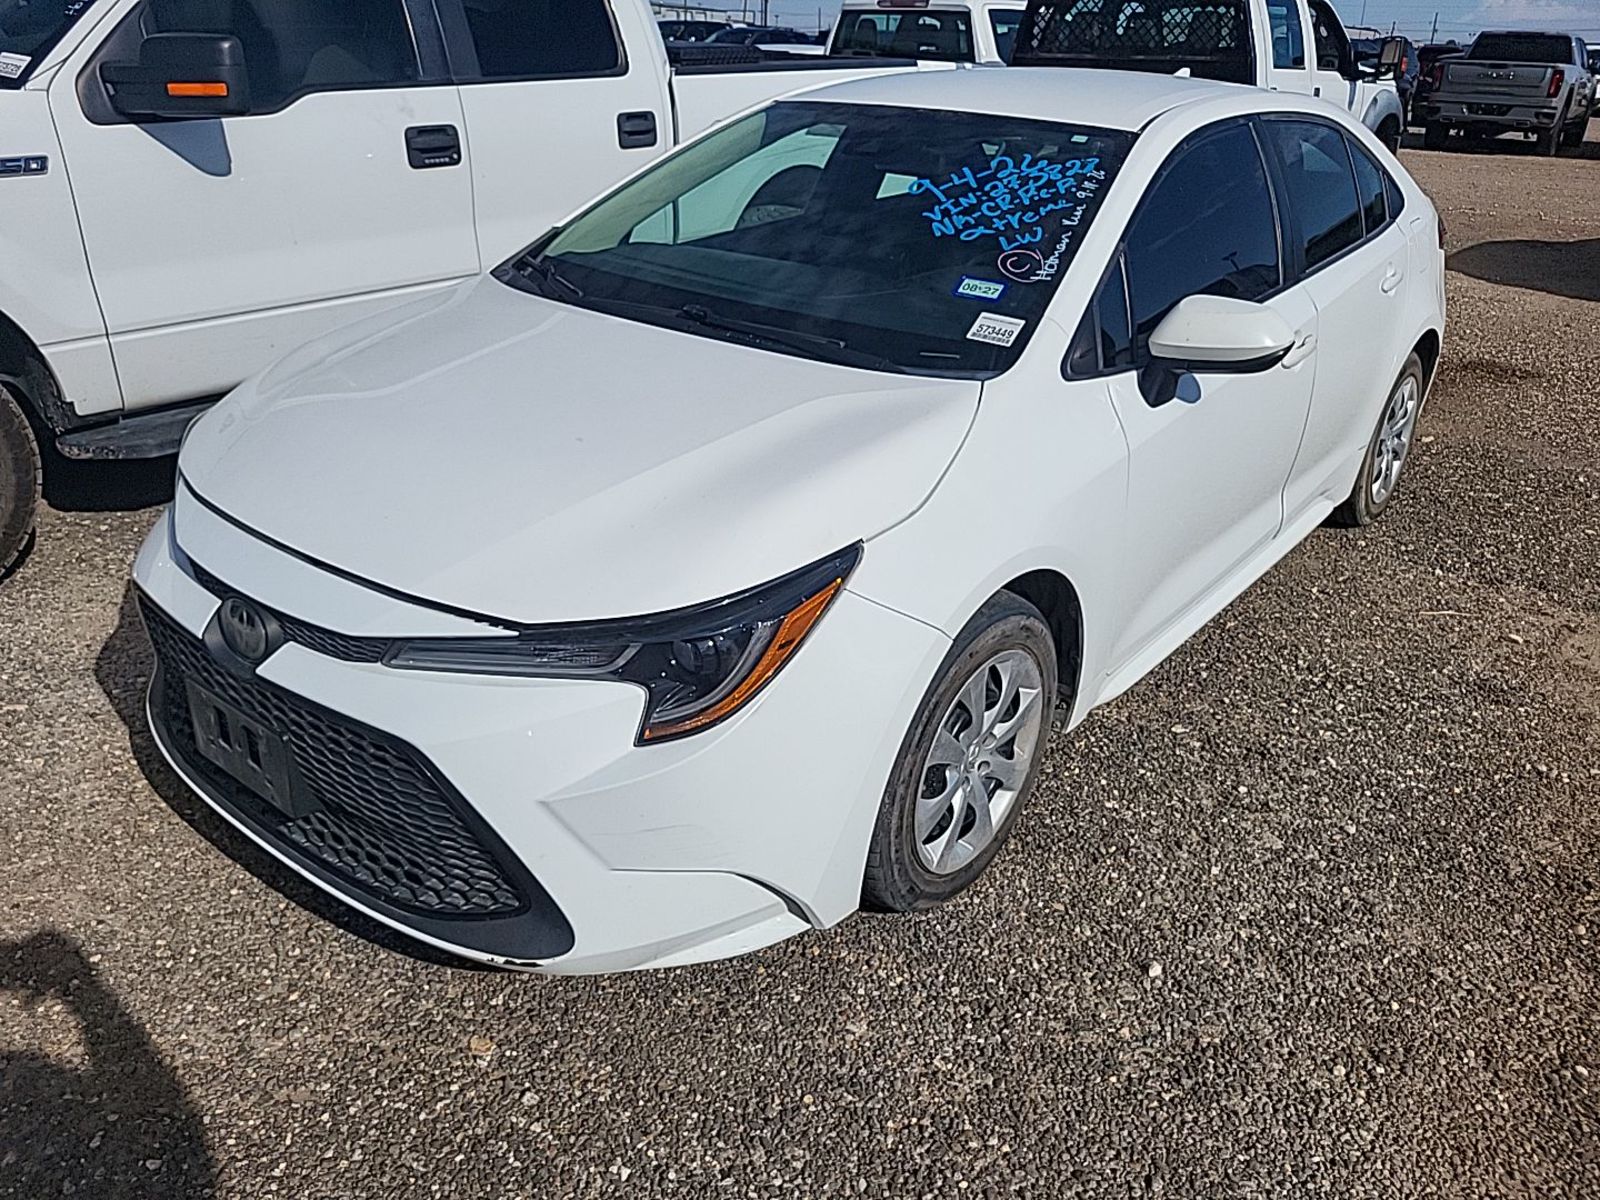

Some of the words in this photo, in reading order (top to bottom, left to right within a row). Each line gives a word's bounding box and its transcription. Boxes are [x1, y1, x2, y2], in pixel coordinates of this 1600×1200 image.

[908, 154, 1048, 201] 9-4-26
[981, 286, 999, 296] 27
[976, 323, 1015, 339] 573449
